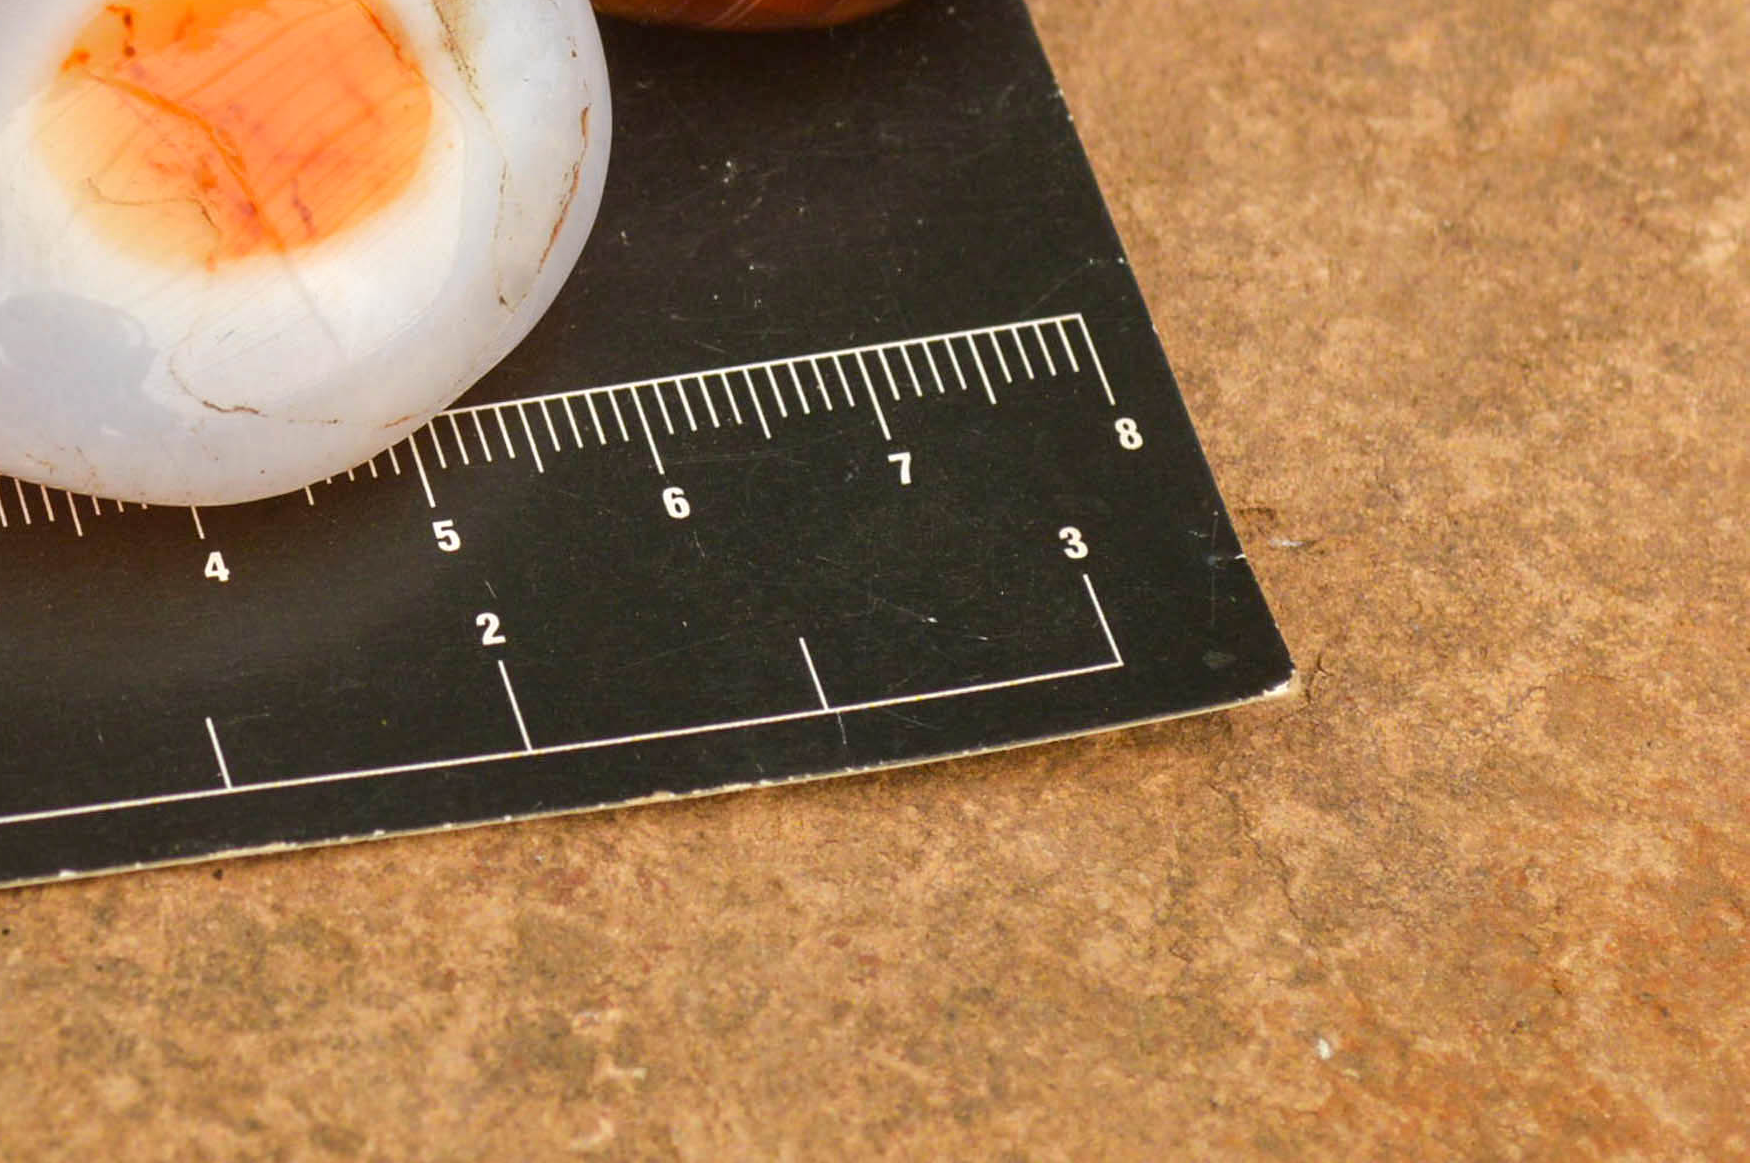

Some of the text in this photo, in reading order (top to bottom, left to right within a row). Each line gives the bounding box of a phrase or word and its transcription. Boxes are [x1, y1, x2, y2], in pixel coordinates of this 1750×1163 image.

[204, 551, 230, 581] 4
[432, 519, 461, 551] 5
[662, 487, 690, 519] 6
[888, 452, 911, 484] 7
[1115, 418, 1143, 449] 8
[476, 612, 506, 645] 2
[1059, 526, 1088, 558] 3
